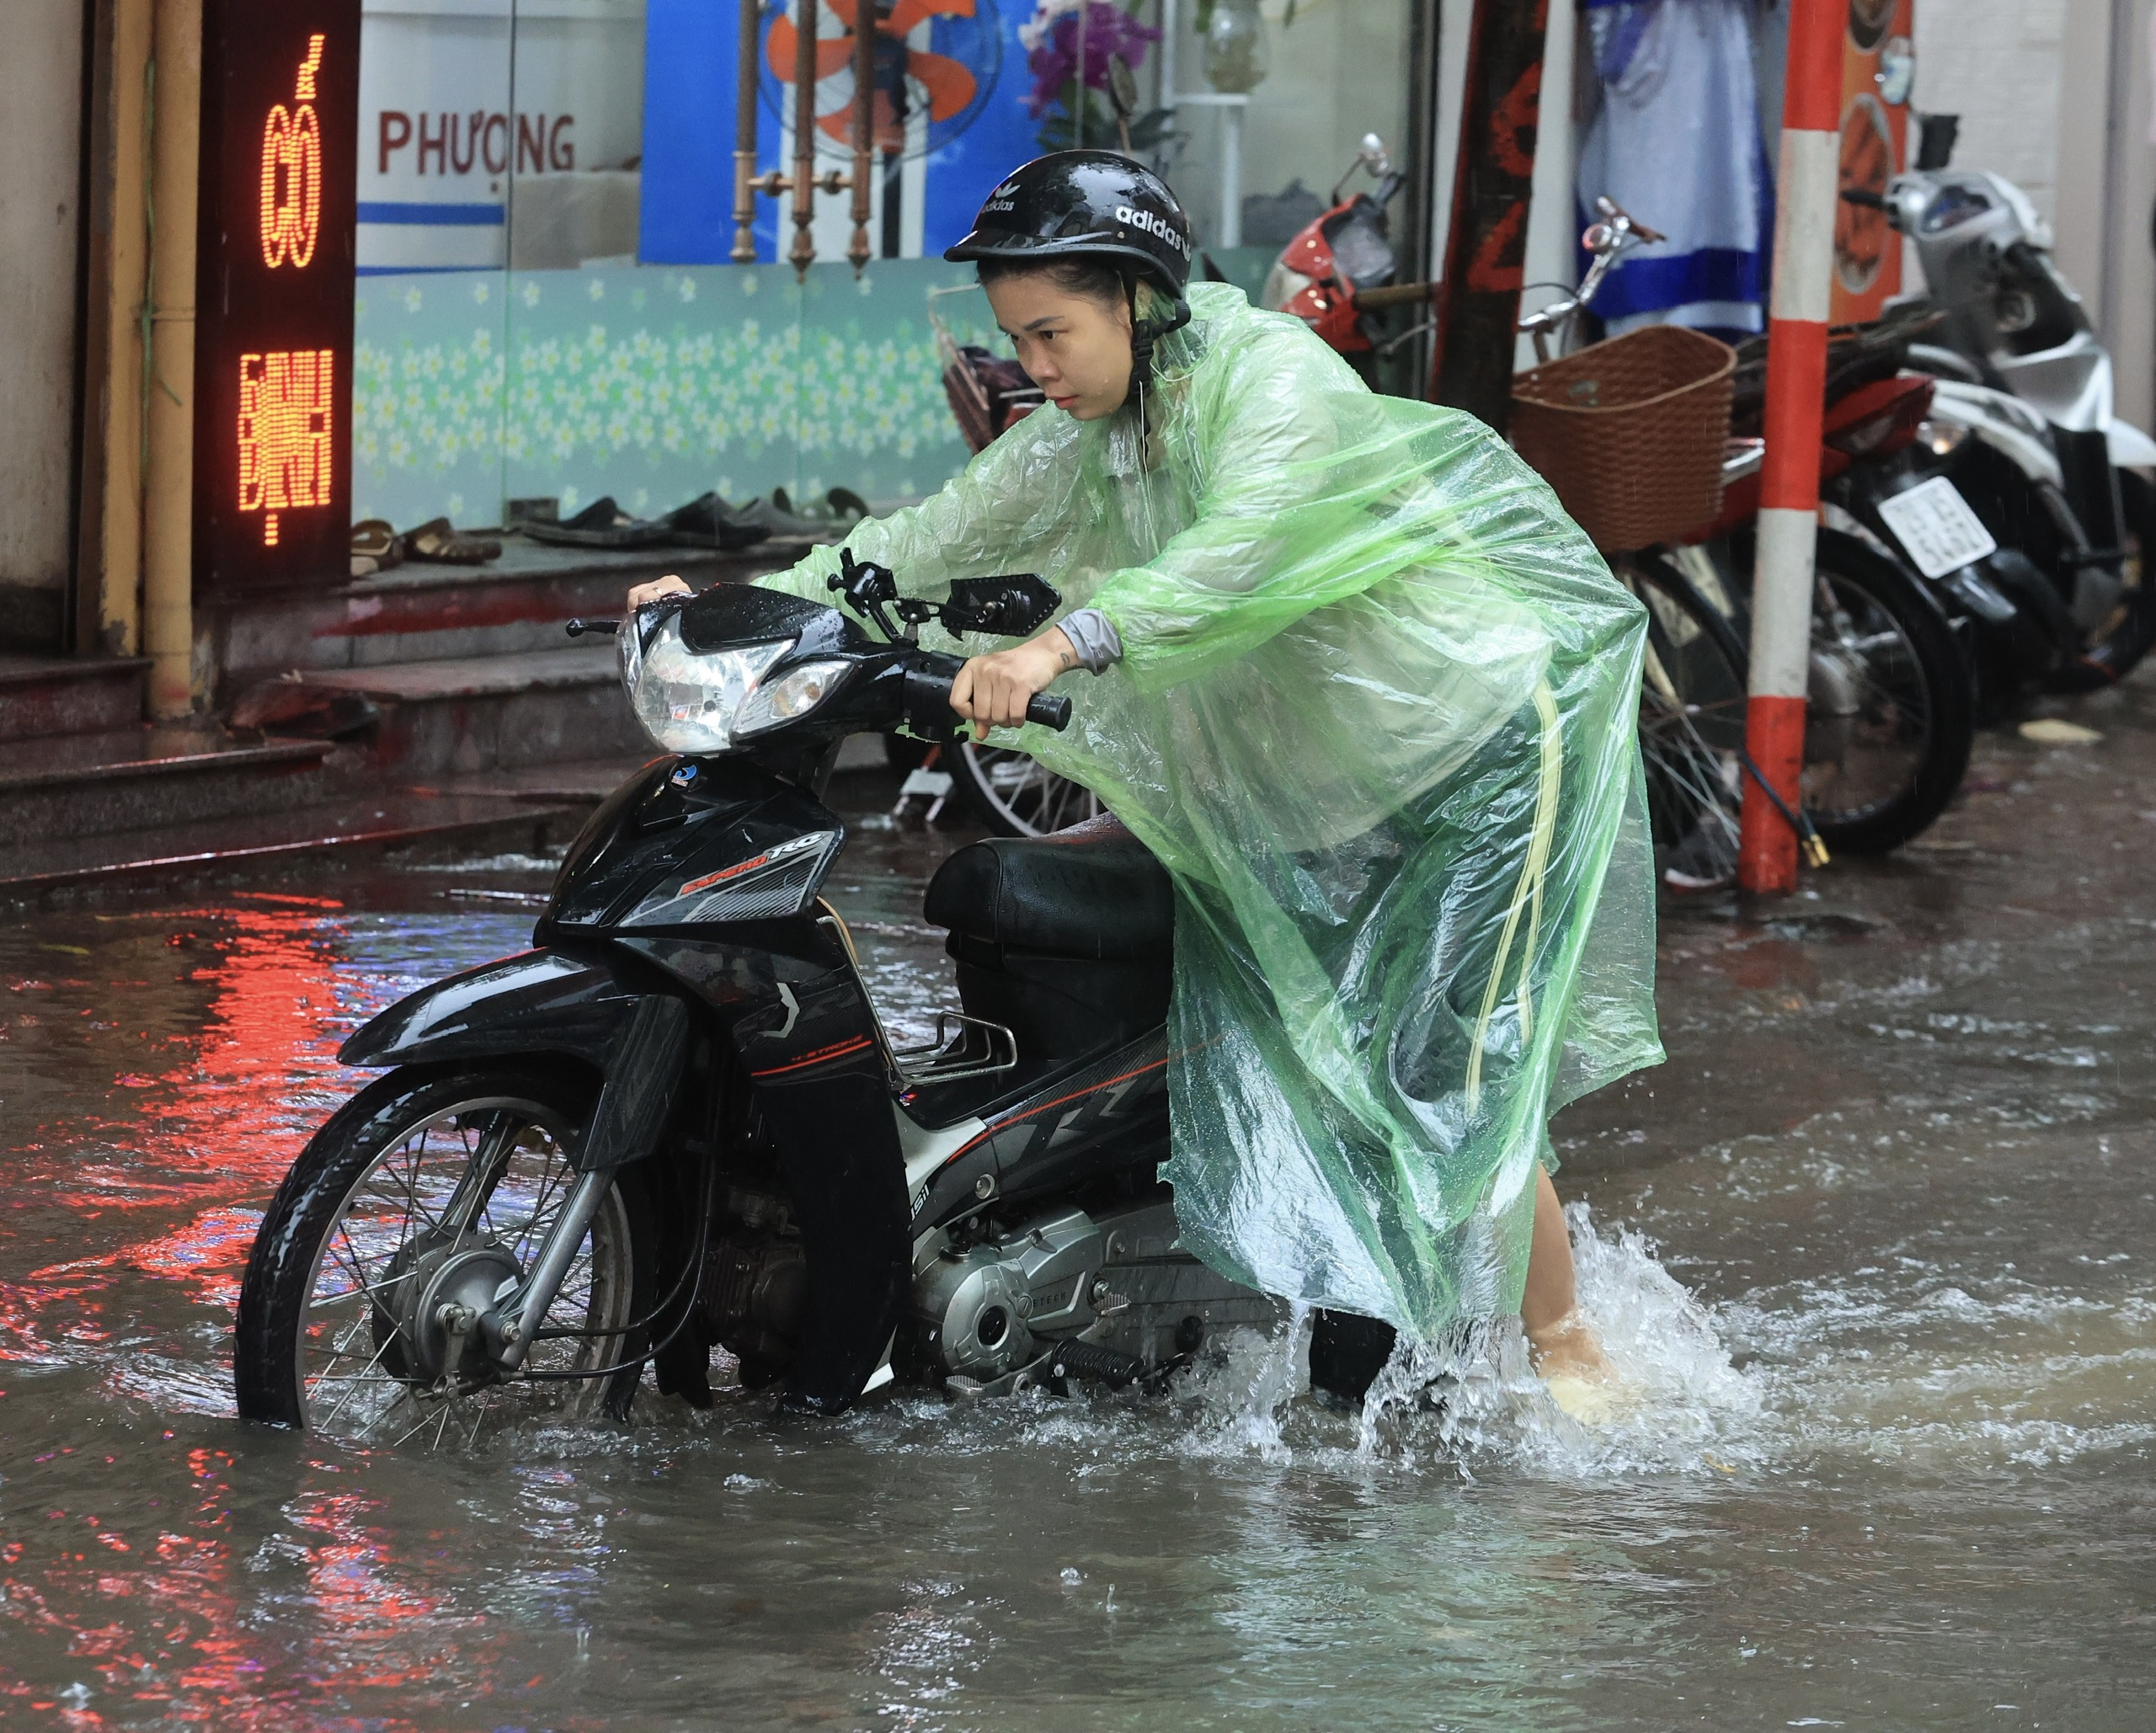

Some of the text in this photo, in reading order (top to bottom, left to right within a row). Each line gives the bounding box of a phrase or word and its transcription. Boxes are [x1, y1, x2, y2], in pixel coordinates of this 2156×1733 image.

[1115, 205, 1182, 251] adidas
[680, 833, 823, 895] ESPERO RC
[1033, 1291, 1066, 1308] ETECH
